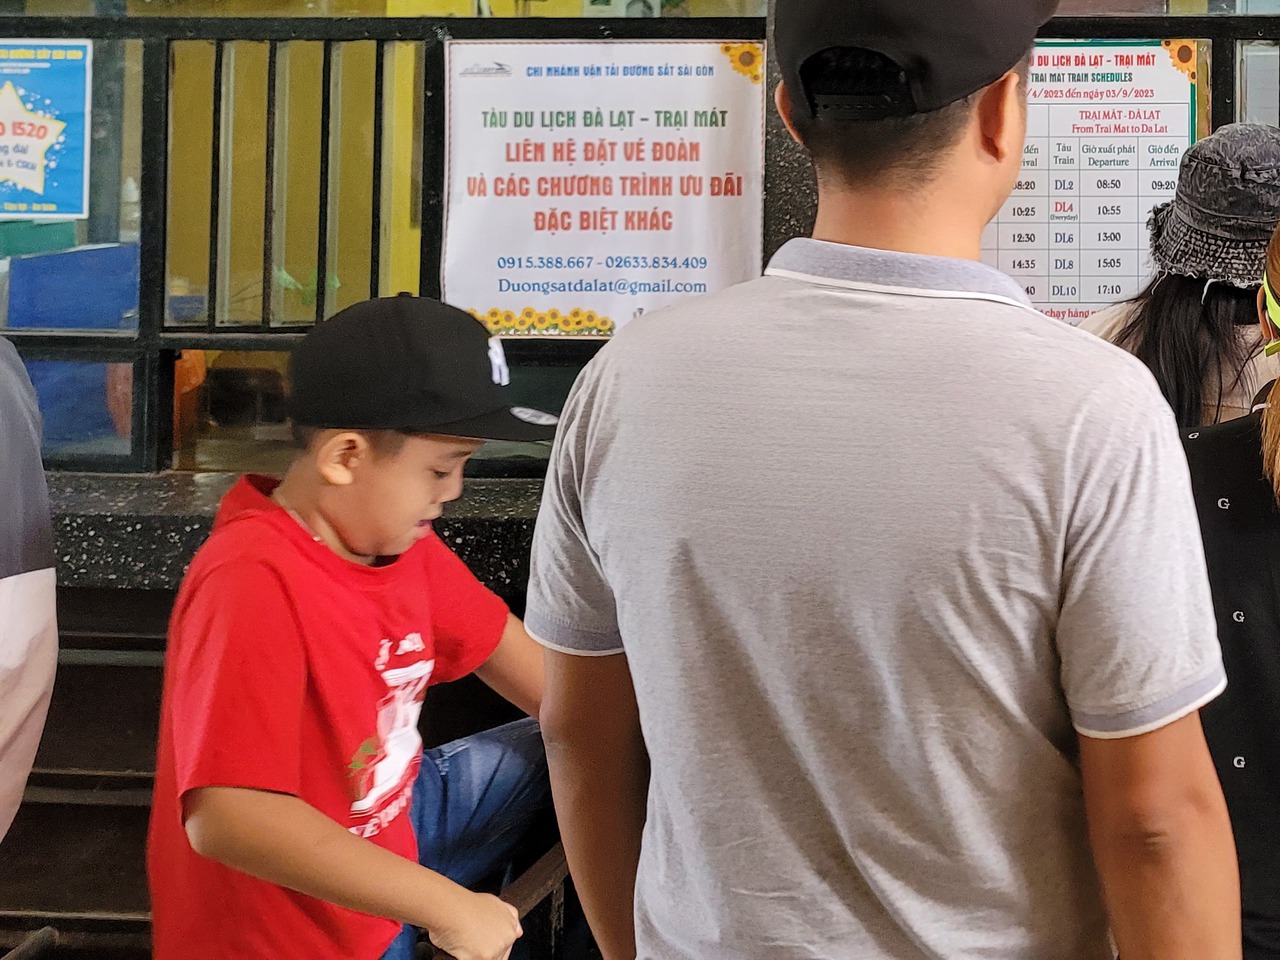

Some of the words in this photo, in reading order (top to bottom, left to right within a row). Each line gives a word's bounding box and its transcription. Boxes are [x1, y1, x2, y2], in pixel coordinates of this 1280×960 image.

[1038, 55, 1050, 67] DU
[1052, 55, 1072, 69] LỊCH
[1074, 52, 1086, 67] ĐÀ
[1088, 55, 1104, 69] LẠT
[1114, 54, 1134, 69] TRẠI
[1136, 52, 1156, 66] MÁT
[527, 66, 543, 77] CHI
[677, 64, 693, 76] SÀI
[1031, 73, 1047, 82] TRAI
[1050, 73, 1066, 82] MAT
[1067, 73, 1089, 82] TRAIN
[1091, 72, 1133, 83] SCHEDULES
[1027, 88, 1064, 99] /4/2023
[1065, 88, 1082, 99] đến
[1083, 89, 1104, 101] ngày
[1105, 87, 1155, 99] 03/9/2023
[482, 107, 507, 128] TÀU
[514, 111, 534, 128] DU
[541, 111, 577, 132] LỊCH
[582, 107, 604, 128] ĐÀ
[609, 110, 635, 131] LẠT
[655, 110, 688, 131] TRẠI
[694, 107, 728, 127] MÁT
[1079, 110, 1101, 121] TRẠI
[1102, 108, 1123, 120] MÁT
[1128, 108, 1142, 120] ĐÀ
[1143, 110, 1161, 121] LẠT
[1072, 124, 1094, 134] From
[1095, 124, 1112, 133] Trai
[1113, 124, 1130, 133] Mat
[1131, 125, 1140, 133] to
[1141, 124, 1153, 133] Da
[1155, 124, 1168, 133] Lat
[505, 138, 545, 162] LIÊN
[553, 138, 577, 166] HỆ
[583, 138, 617, 166] ĐẶT
[623, 138, 645, 162] VÉ
[651, 137, 701, 162] ĐOÀN
[1024, 144, 1039, 154] đến
[1056, 143, 1072, 152] Tàu
[1082, 144, 1097, 154] Giờ
[1097, 144, 1116, 154] xuất
[1117, 144, 1136, 155] phát
[1148, 144, 1163, 154] Giờ
[1164, 144, 1179, 154] đến
[1053, 155, 1075, 165] Train
[1088, 158, 1130, 168] Departure
[1149, 157, 1178, 167] Arrival
[467, 172, 487, 197] VÀ
[494, 172, 530, 197] CÁC
[537, 174, 613, 197] CHƯƠNG
[620, 171, 673, 196] TRÌNH
[680, 174, 703, 196] ƯU
[710, 172, 743, 197] ĐÃI
[1054, 180, 1074, 190] DL2
[1096, 179, 1121, 189] 08:50
[1151, 180, 1176, 190] 09:20
[1012, 207, 1036, 217] 10:25
[1054, 202, 1074, 212] DL4
[1097, 206, 1121, 215] 10:55
[534, 207, 572, 235] ĐẶC
[579, 206, 618, 235] BIỆT
[624, 206, 673, 231] KHÁC
[1012, 233, 1036, 243] 12:30
[1054, 232, 1074, 243] DL6
[1097, 232, 1121, 242] 13:00
[497, 256, 593, 269] 0915.388.667
[605, 256, 708, 269] 02633.834.409
[1012, 259, 1036, 269] 14:35
[1054, 259, 1074, 270] DL8
[1097, 258, 1121, 268] 15:05
[498, 278, 707, 296] Duongsatdalat@gmail.com
[1052, 285, 1077, 296] DL10
[1097, 285, 1121, 295] 17:10
[1217, 497, 1231, 510] G
[1232, 610, 1245, 623] G
[1233, 755, 1246, 769] G
